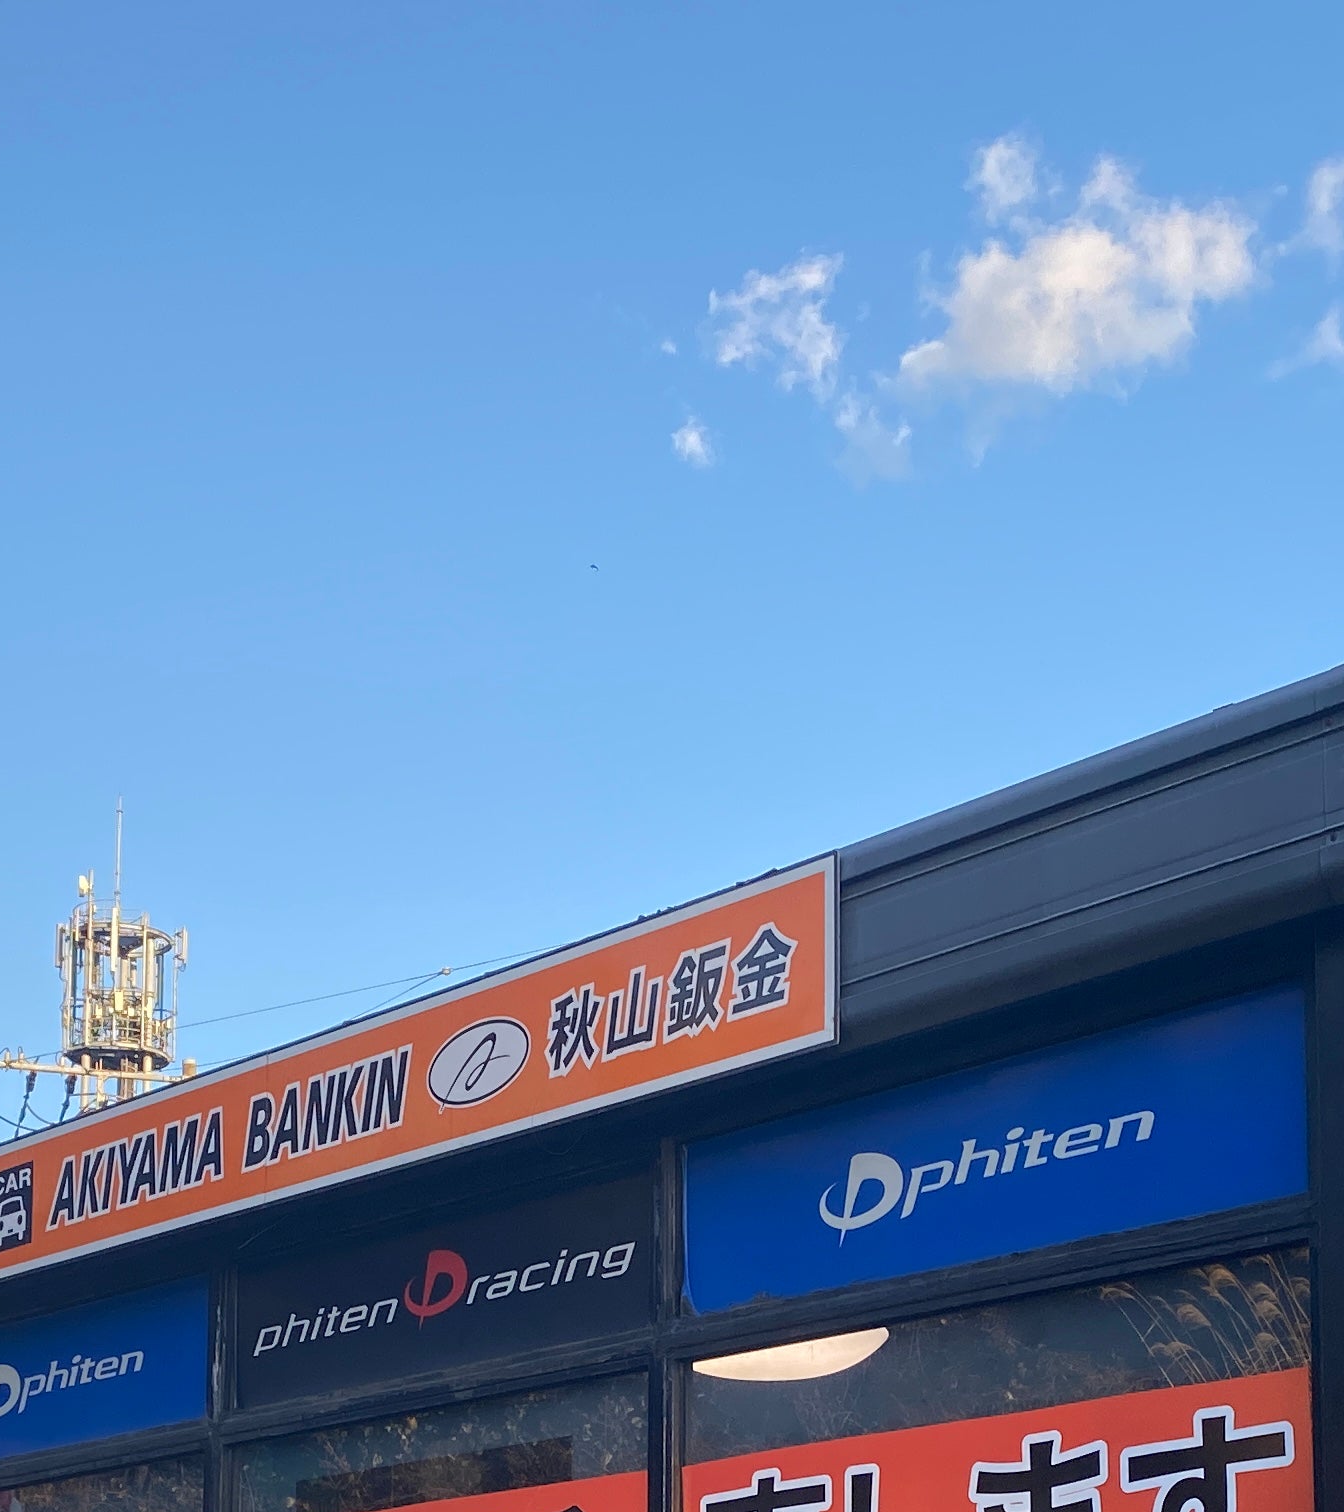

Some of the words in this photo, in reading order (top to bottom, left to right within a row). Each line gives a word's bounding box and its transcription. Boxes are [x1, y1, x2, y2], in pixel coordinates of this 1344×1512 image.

[546, 920, 796, 1079] 秋山鈑金
[45, 1106, 224, 1231] AKIYAMA
[241, 1043, 413, 1173] BANKIN
[901, 1109, 1155, 1219] phiten
[253, 1294, 397, 1358] phiten
[465, 1240, 635, 1312] racing
[16, 1348, 143, 1406] phiten
